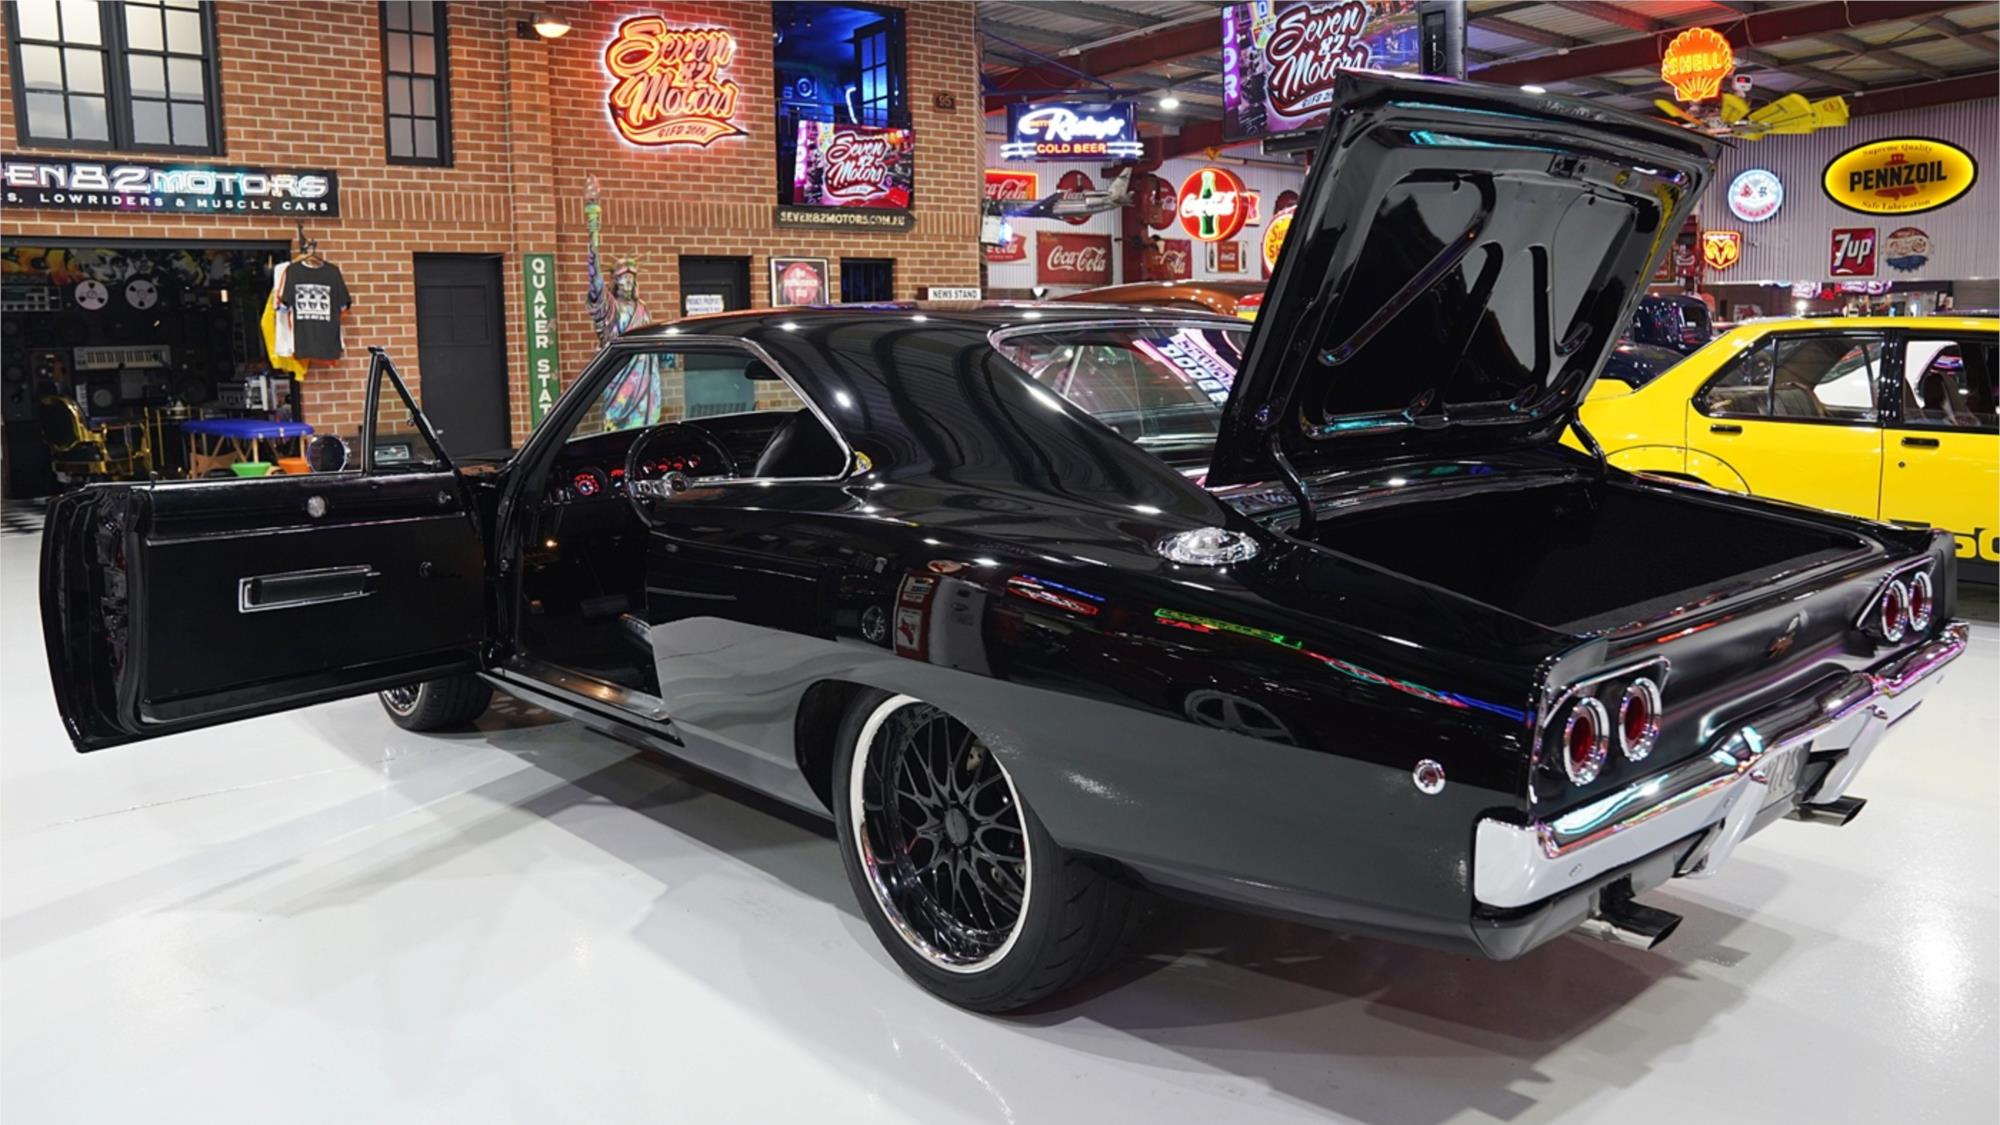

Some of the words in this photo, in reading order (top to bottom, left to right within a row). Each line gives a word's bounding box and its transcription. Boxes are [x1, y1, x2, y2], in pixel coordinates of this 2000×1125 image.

[1270, 7, 1360, 61] Seven
[1319, 34, 1347, 56] 82
[609, 19, 732, 77] Seven
[680, 62, 712, 85] 82
[1274, 51, 1364, 98] Motors
[1665, 52, 1722, 75] SHELL
[615, 72, 739, 125] Motors
[828, 134, 883, 163] Seven
[1037, 143, 1070, 153] COLD
[1074, 143, 1107, 153] BEER
[1901, 143, 1932, 155] Quality
[827, 160, 883, 186] Motors
[1849, 160, 1948, 193] PENNZOIL
[40, 193, 163, 207] LOWRIDERS
[176, 198, 185, 207] &
[197, 199, 272, 210] MUSCLE
[282, 201, 328, 211] CARS
[1047, 245, 1106, 272] Coca-Cola
[1832, 233, 1872, 268] 7up
[532, 258, 549, 349] QUAKER
[933, 290, 952, 299] NEWS
[954, 290, 978, 299] STAND
